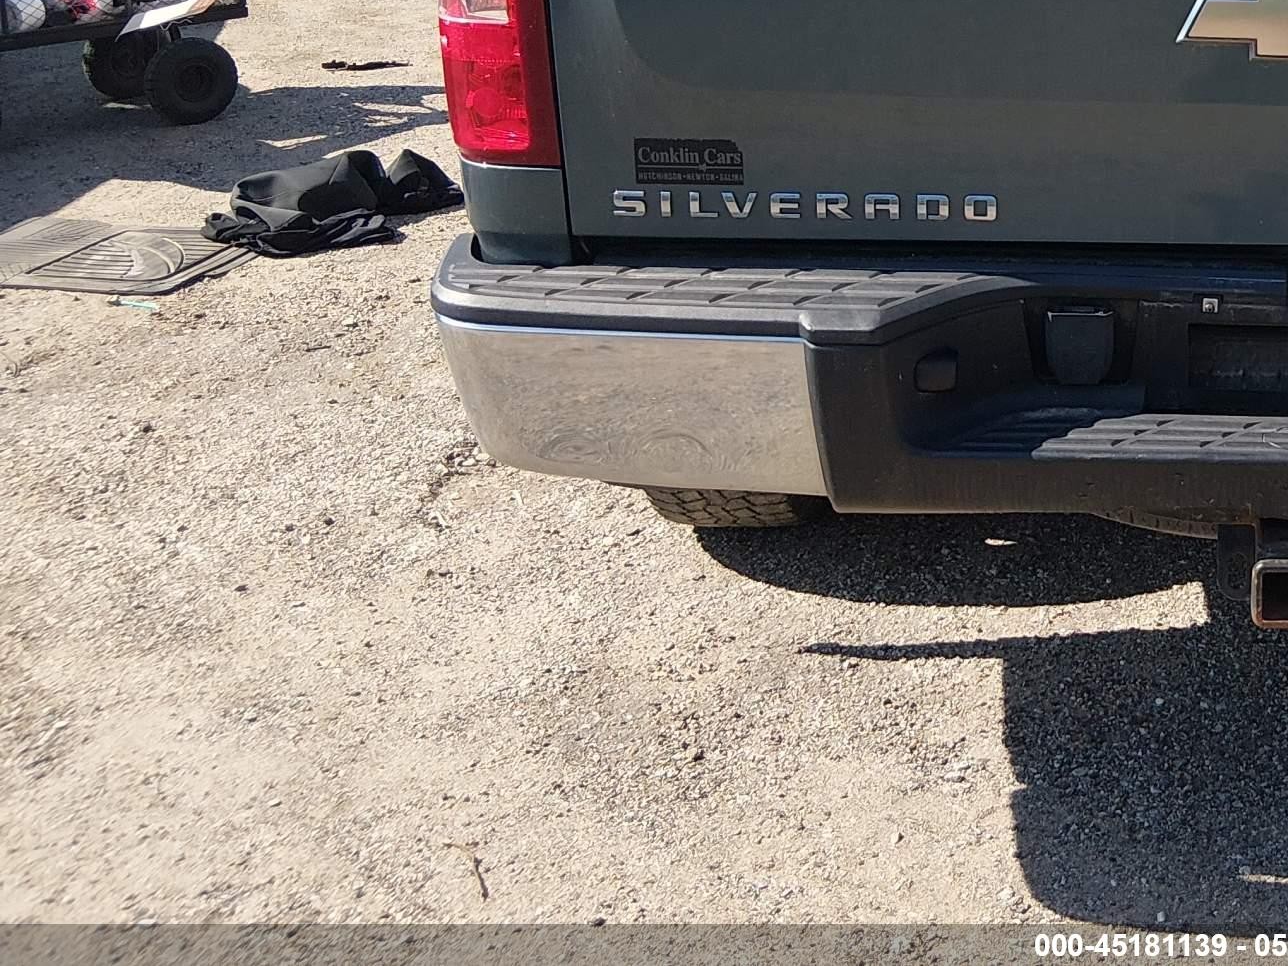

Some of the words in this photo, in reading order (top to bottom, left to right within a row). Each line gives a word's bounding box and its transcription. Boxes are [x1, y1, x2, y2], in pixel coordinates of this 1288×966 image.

[638, 146, 700, 164] Conklin
[703, 147, 742, 165] Cars
[612, 189, 998, 221] SILVERADO
